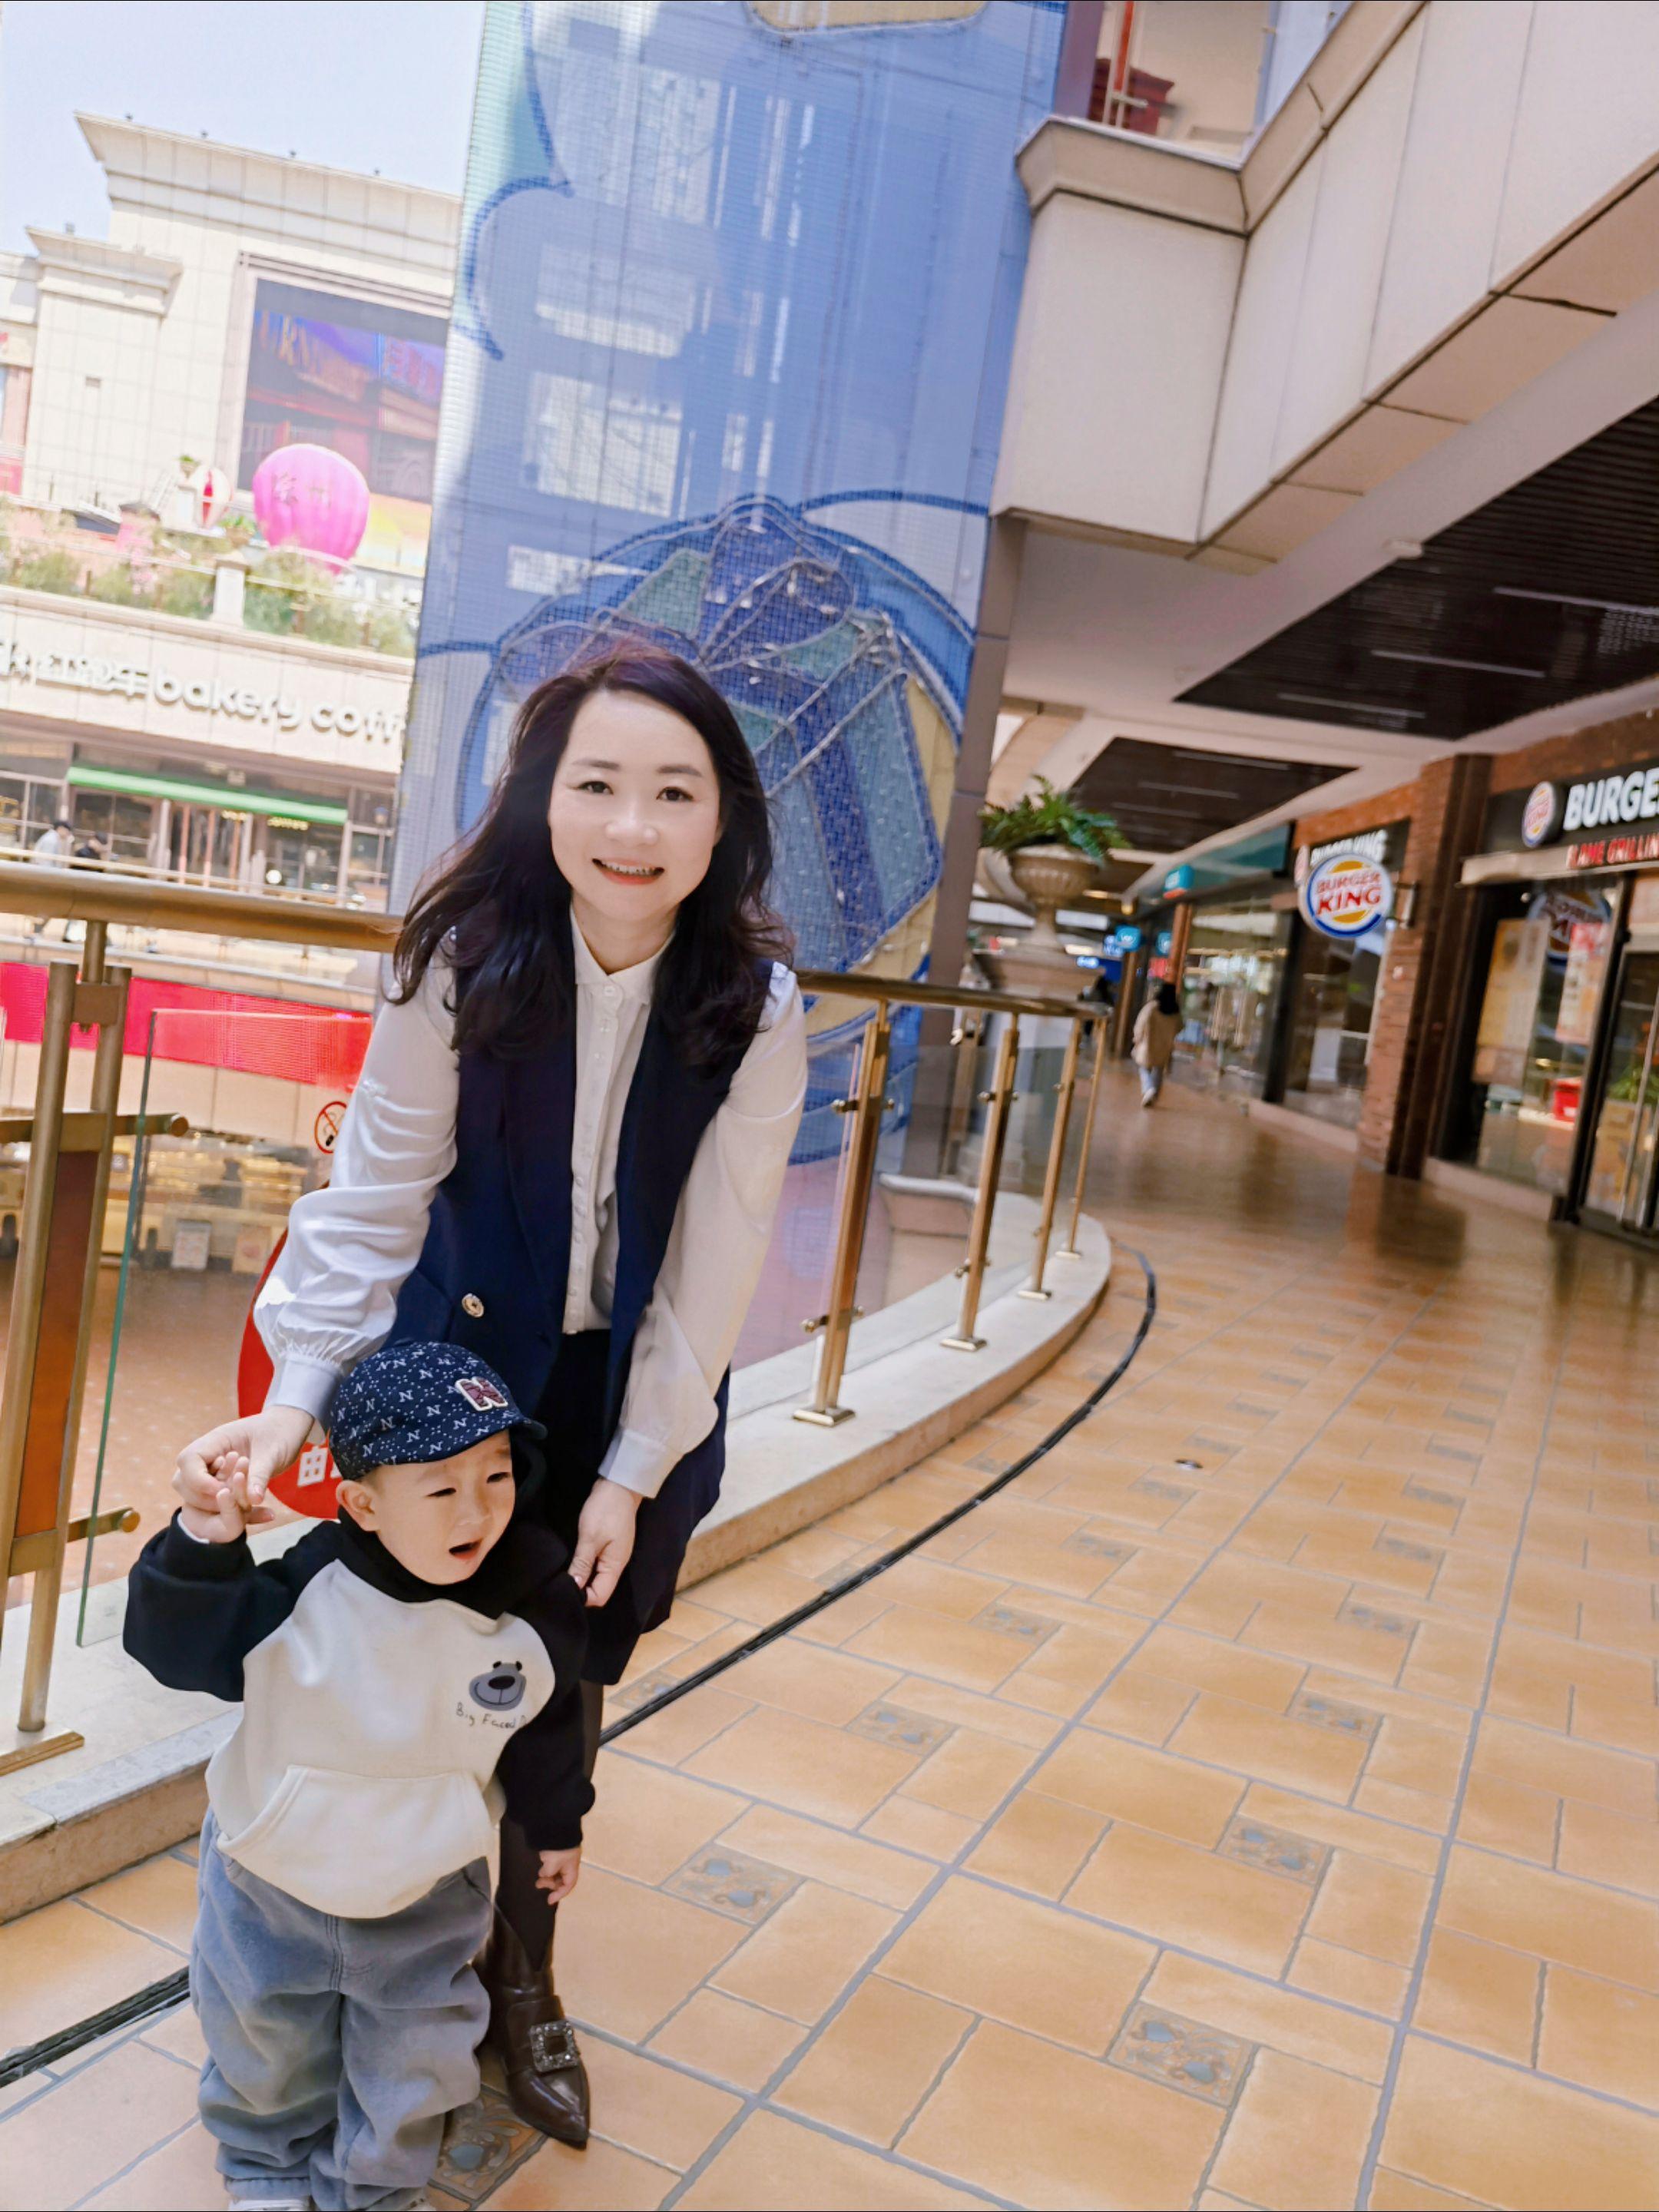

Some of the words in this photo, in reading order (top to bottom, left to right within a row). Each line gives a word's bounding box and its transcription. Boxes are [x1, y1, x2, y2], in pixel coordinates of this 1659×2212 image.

[154, 667, 303, 728] bakery
[310, 701, 416, 739] coff
[1316, 872, 1381, 894] BURGER
[1316, 886, 1382, 916] KING
